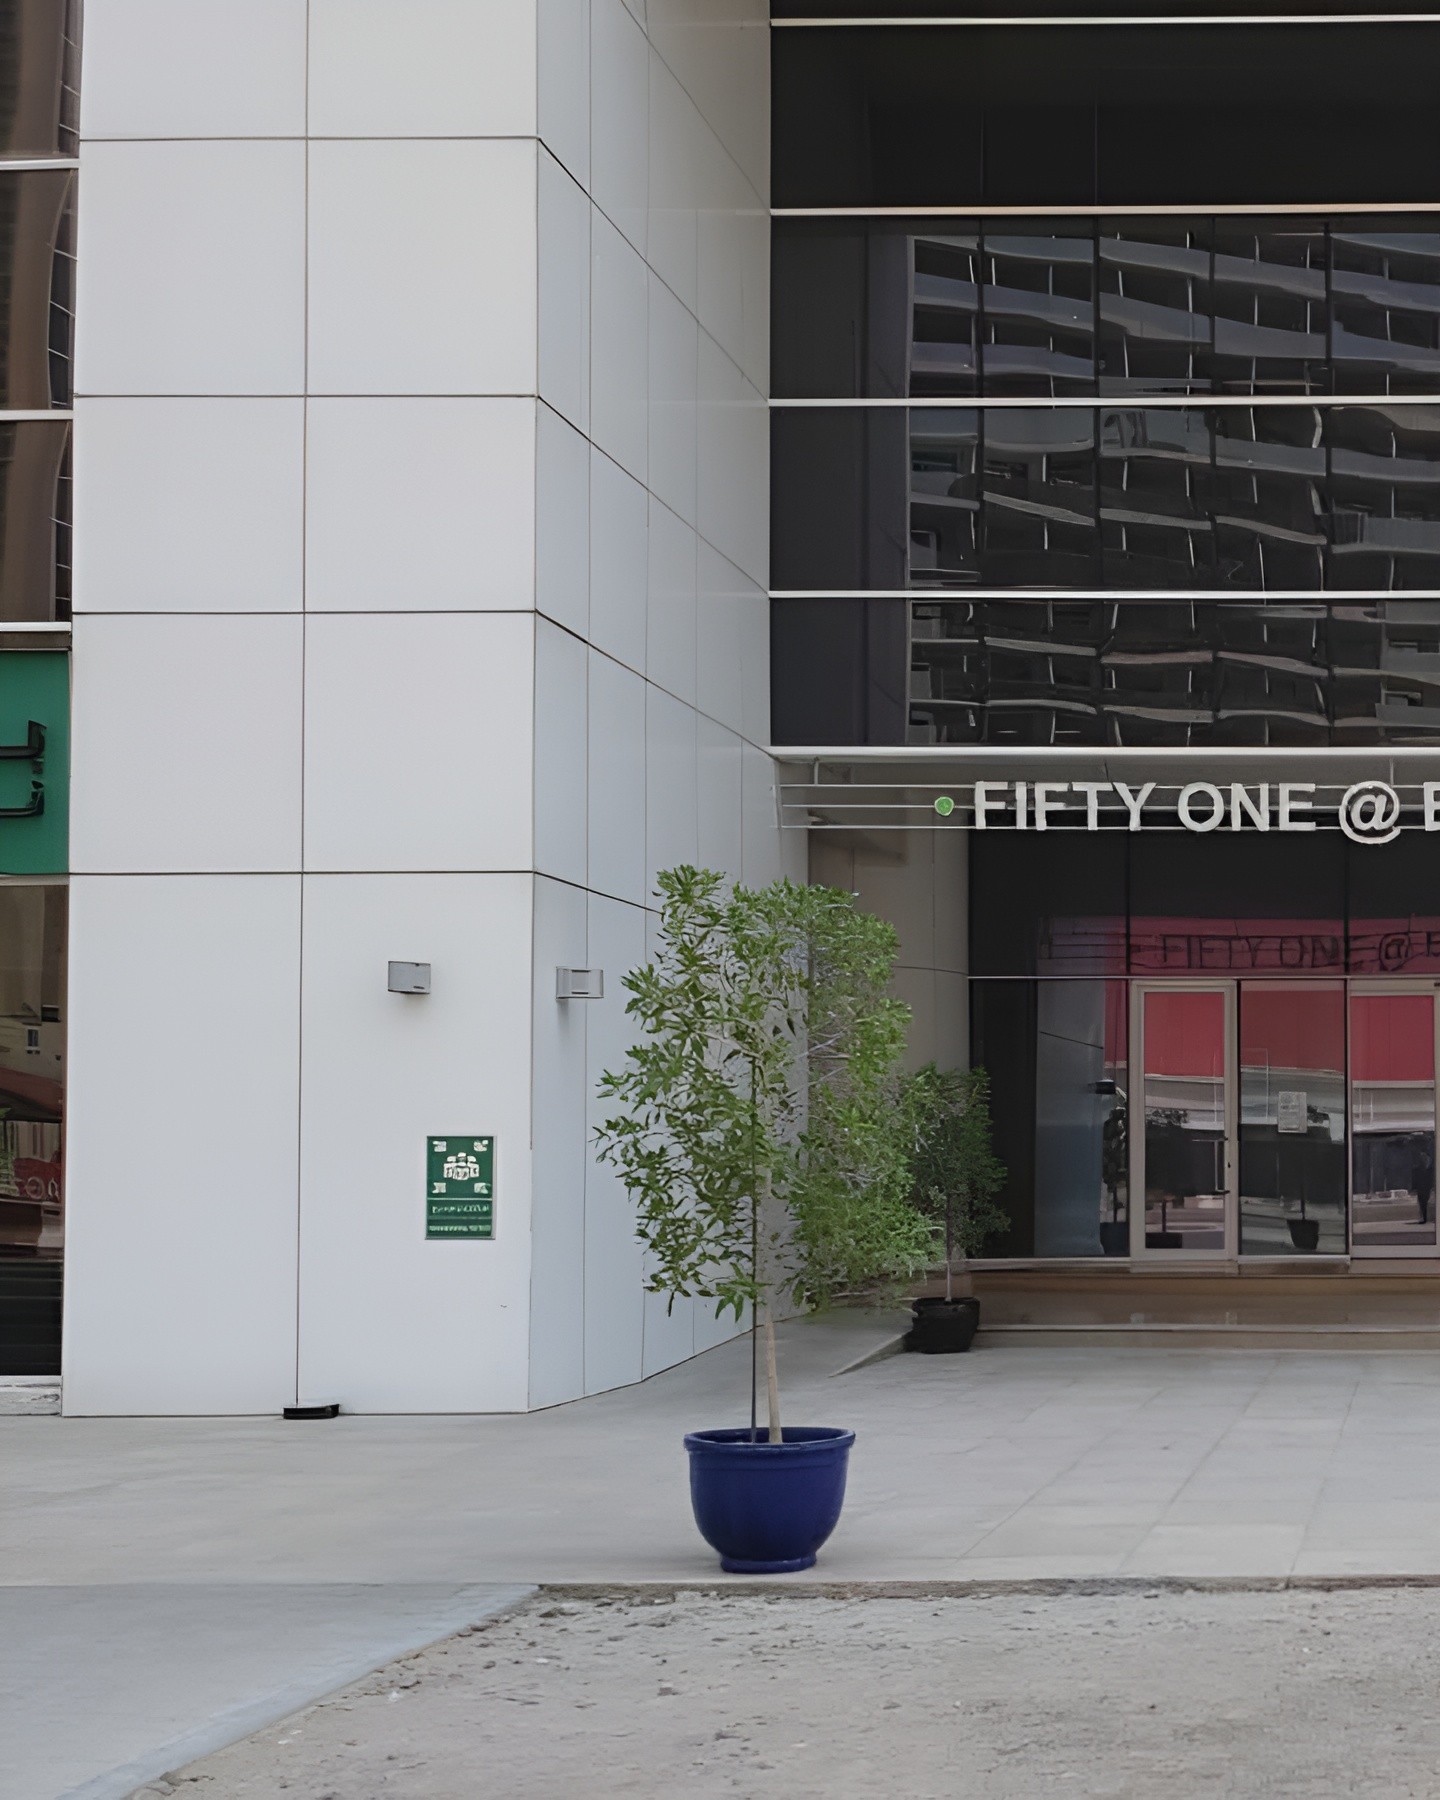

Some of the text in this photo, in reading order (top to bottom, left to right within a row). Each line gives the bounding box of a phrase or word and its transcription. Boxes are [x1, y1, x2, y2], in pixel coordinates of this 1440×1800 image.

[974, 781, 1157, 832] FIFTY
[1177, 781, 1317, 832] ONE
[1338, 780, 1402, 845] @
